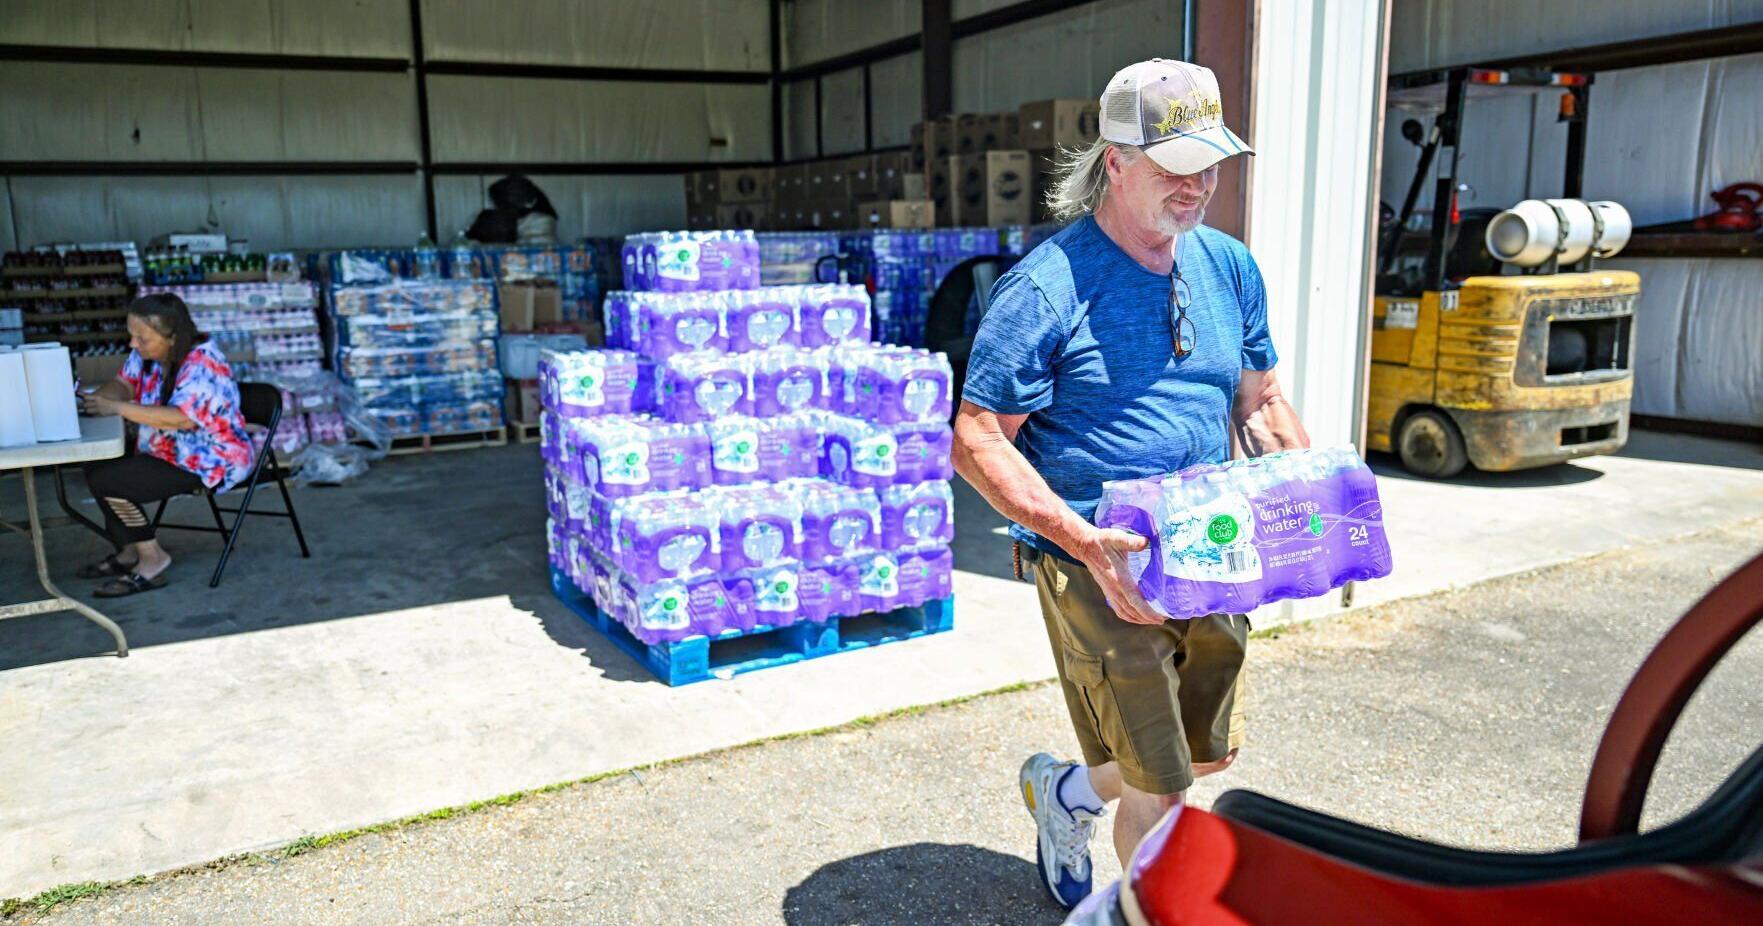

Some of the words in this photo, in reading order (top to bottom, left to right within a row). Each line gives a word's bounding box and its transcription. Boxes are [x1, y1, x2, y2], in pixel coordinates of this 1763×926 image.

[1260, 500, 1313, 521] drinking
[1211, 520, 1232, 531] food
[1214, 529, 1233, 539] club
[1262, 517, 1303, 534] water
[1348, 524, 1369, 541] 24
